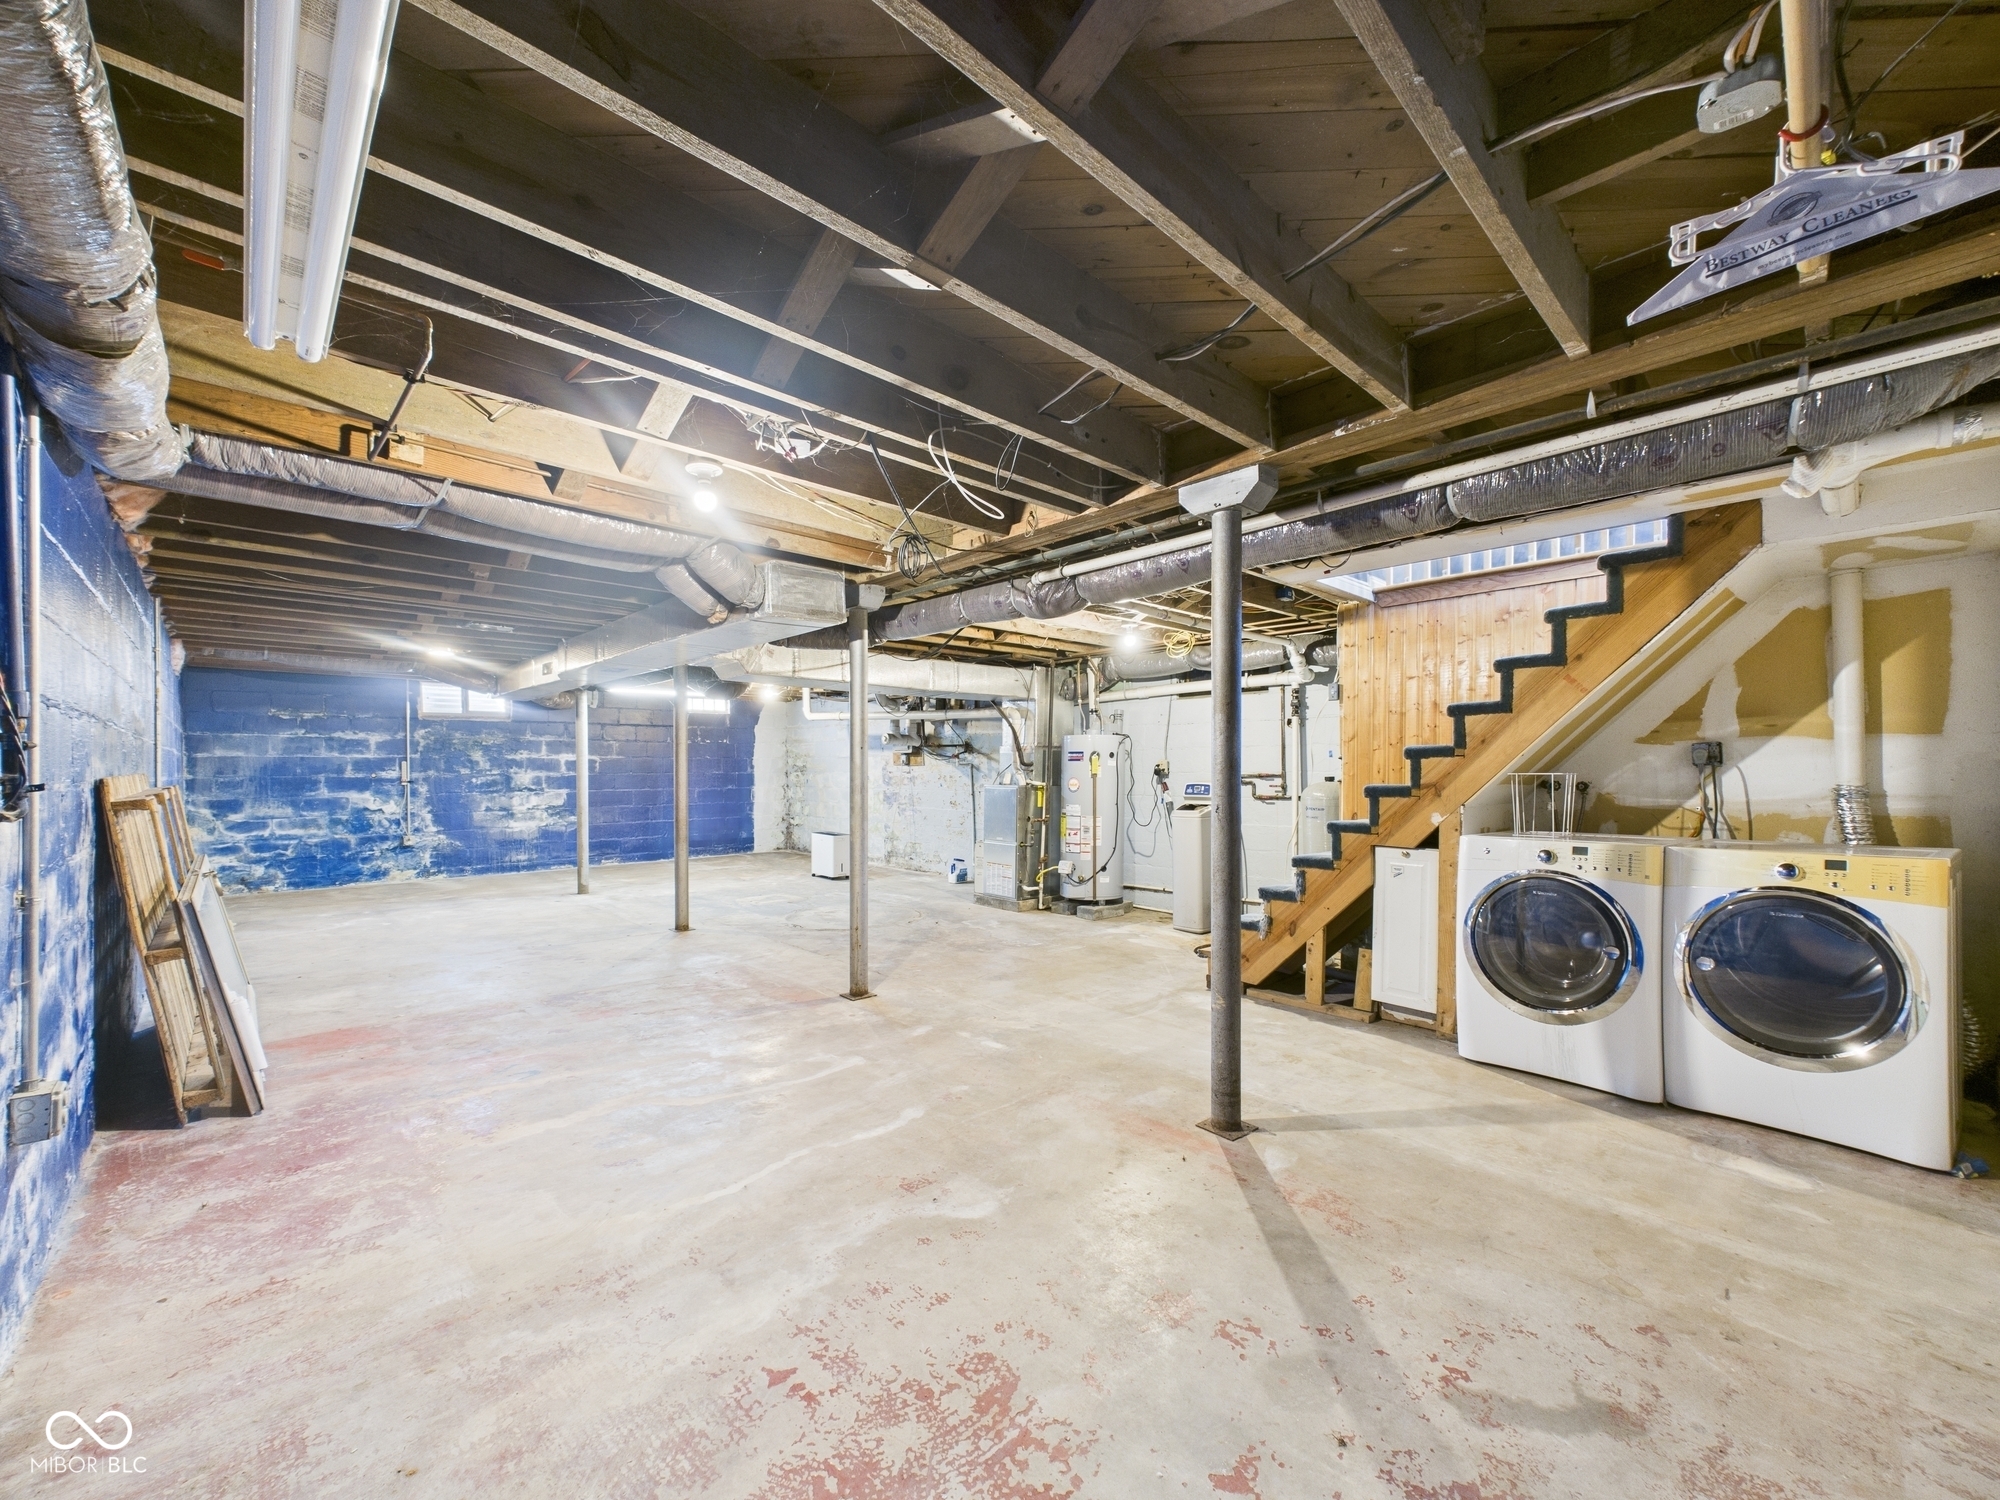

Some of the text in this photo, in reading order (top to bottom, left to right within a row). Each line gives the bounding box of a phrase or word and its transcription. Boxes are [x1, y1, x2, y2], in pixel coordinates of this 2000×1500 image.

[1703, 232, 1790, 273] BESTWAY
[1802, 190, 1912, 234] CLEANERS
[1757, 231, 1853, 269] mybestwaycleaners.com
